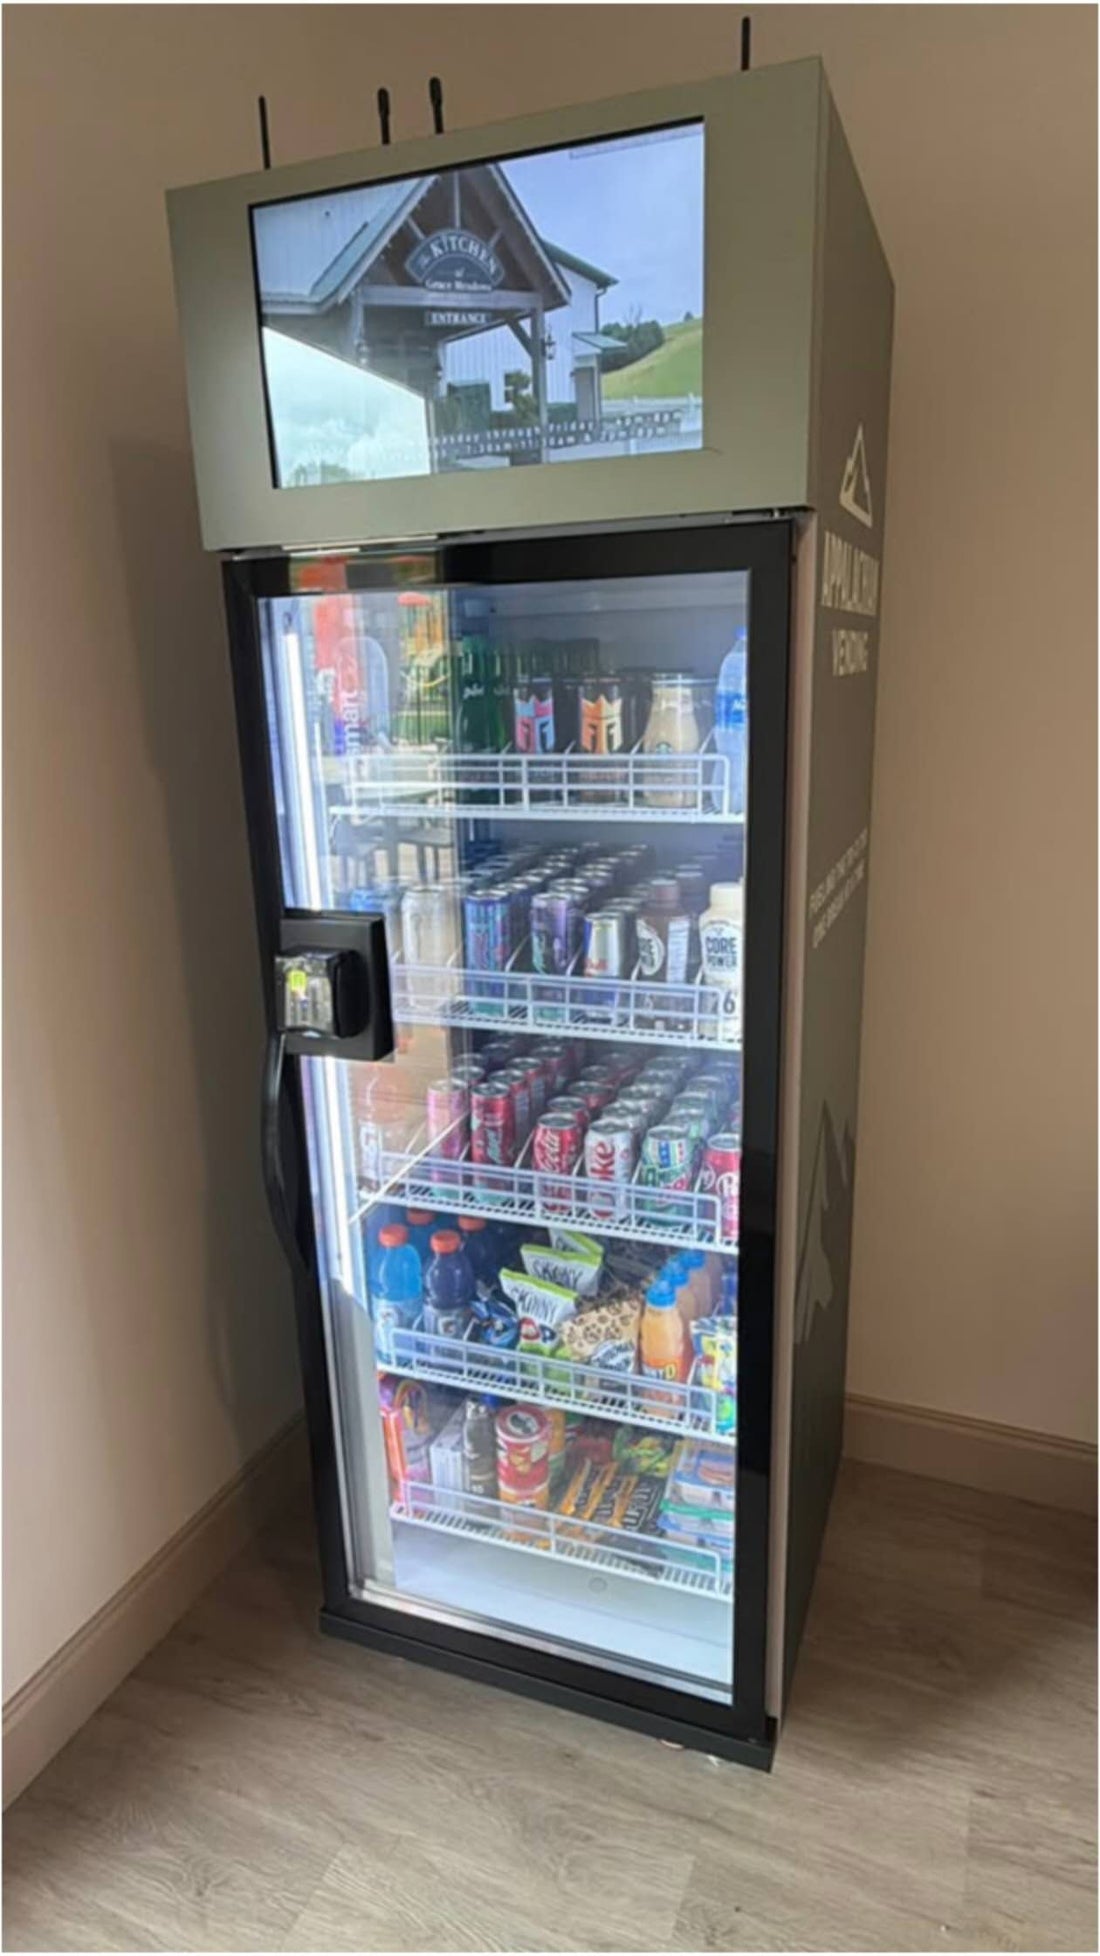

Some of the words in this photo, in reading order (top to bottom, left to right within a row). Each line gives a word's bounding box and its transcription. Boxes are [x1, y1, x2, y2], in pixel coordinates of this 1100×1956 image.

[429, 234, 496, 275] KITCHEN
[431, 311, 487, 325] ENTRANCE
[706, 935, 737, 955] CORE
[707, 956, 738, 970] POWER
